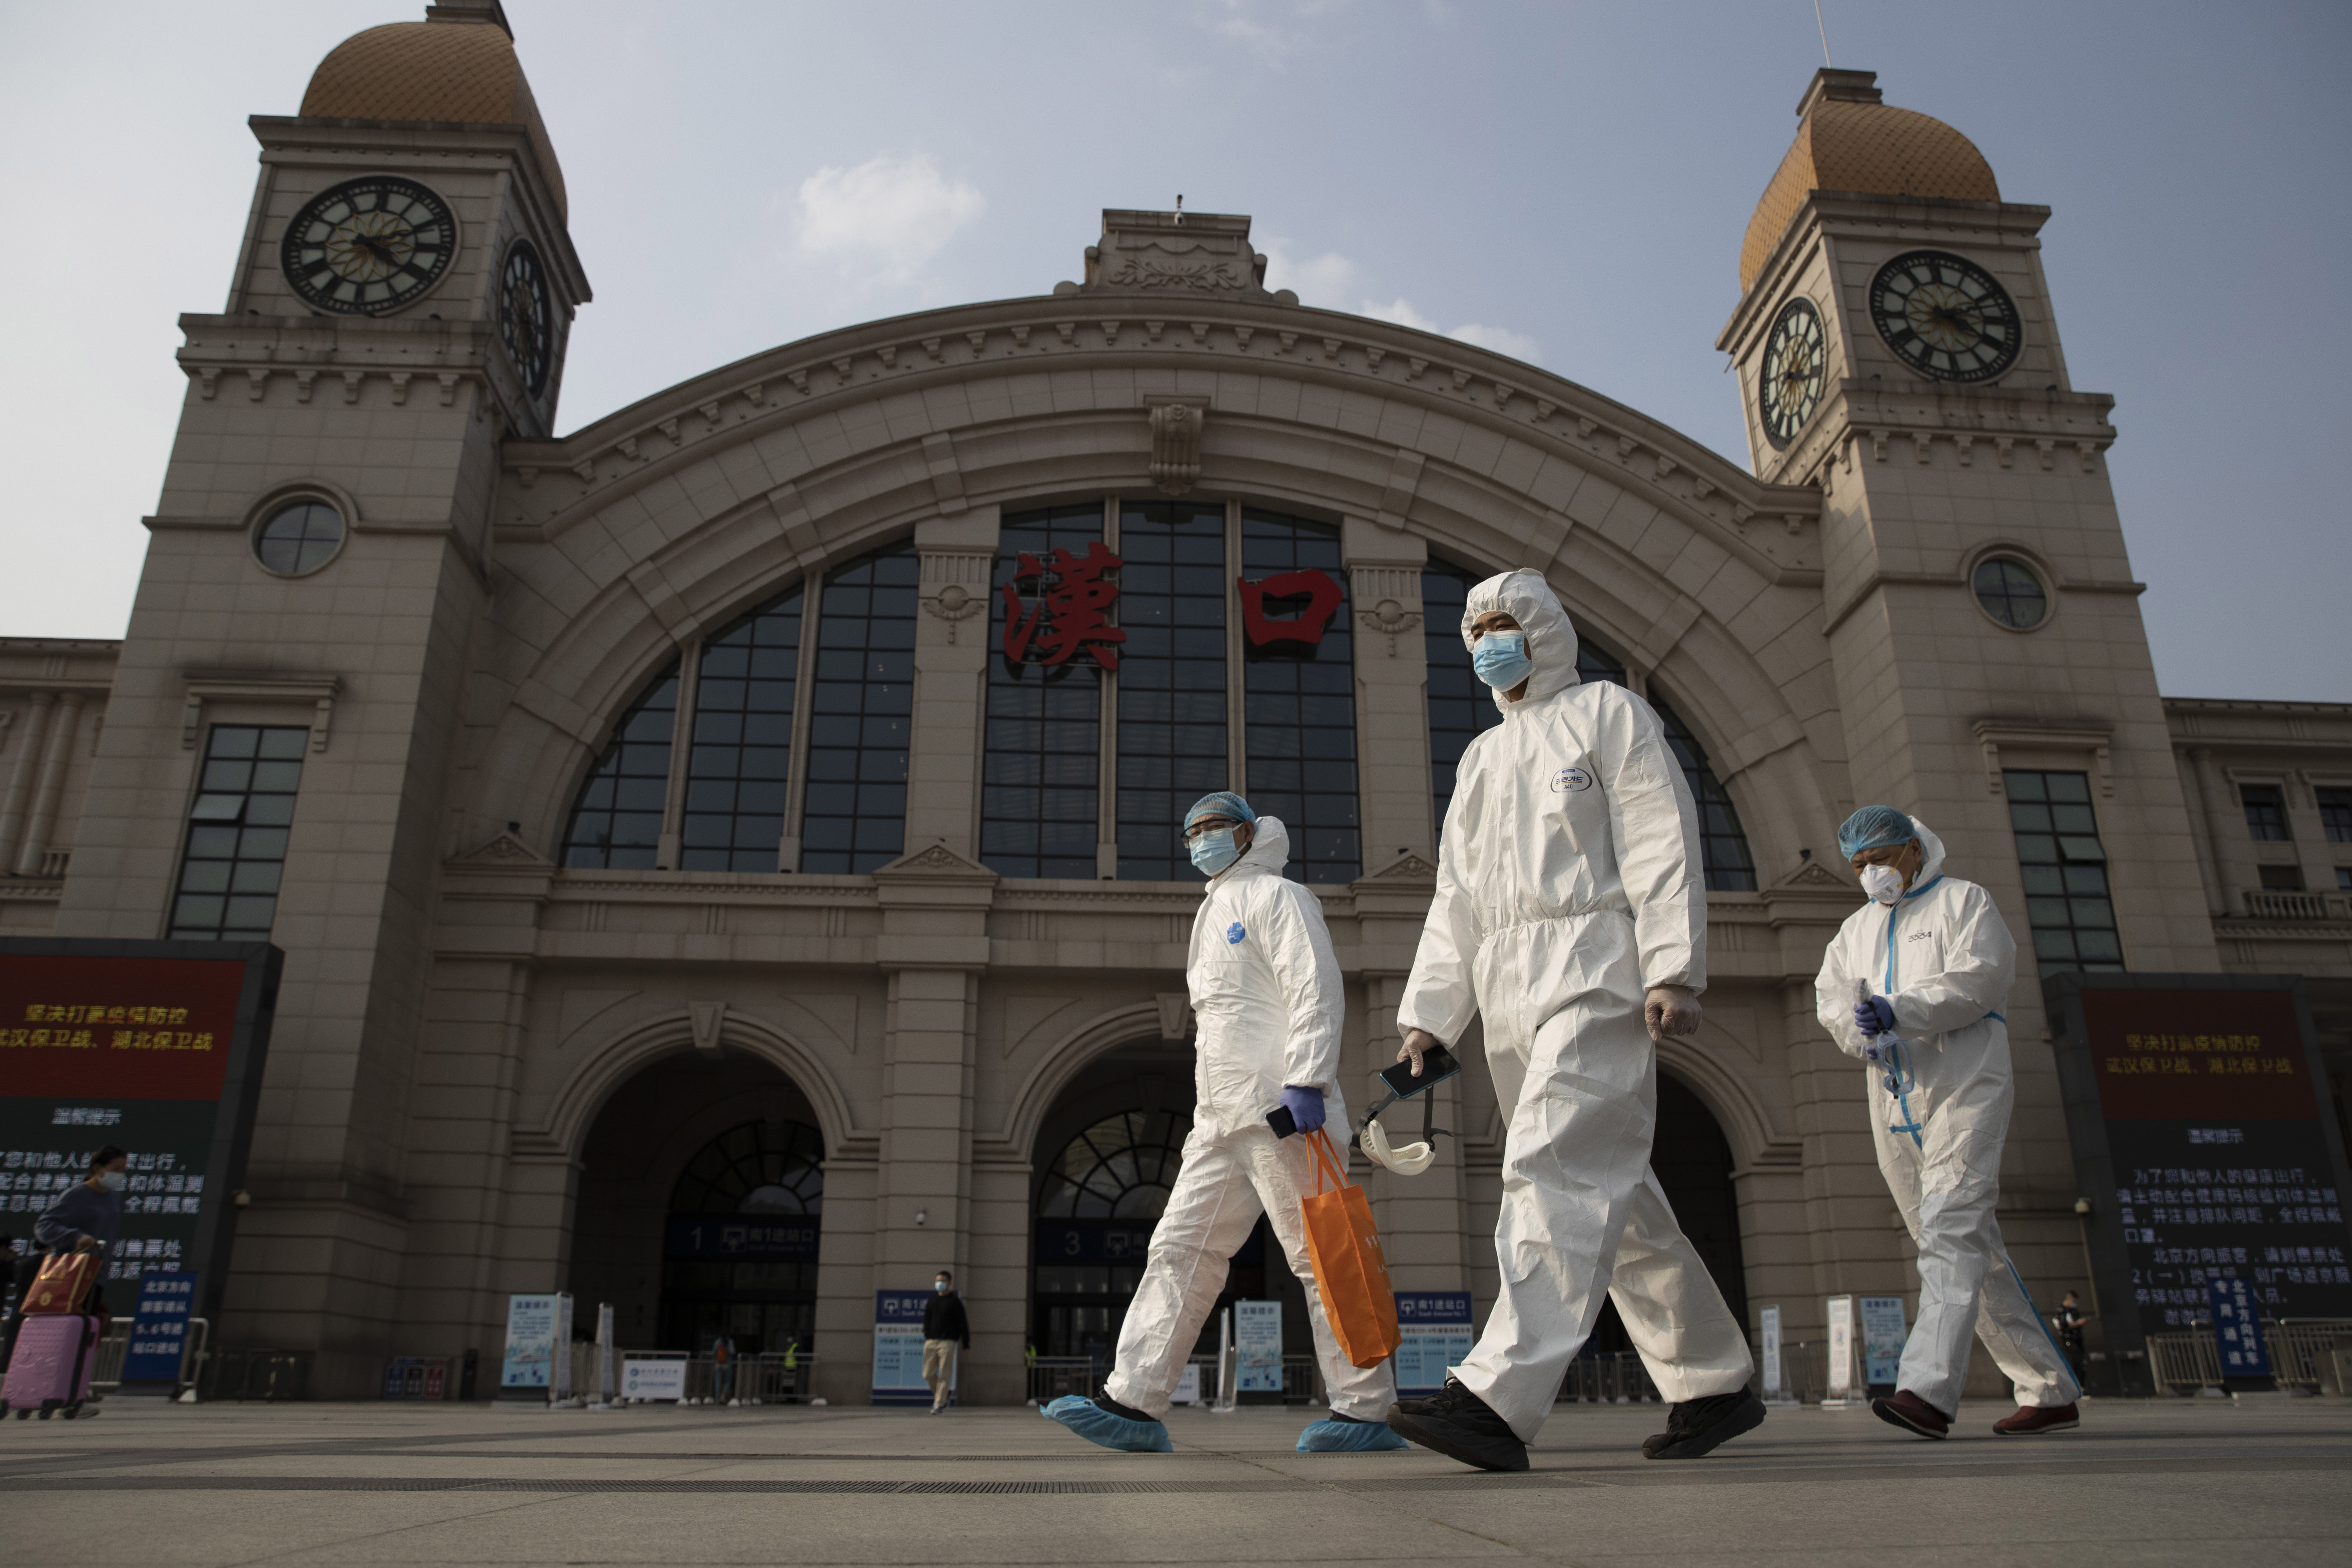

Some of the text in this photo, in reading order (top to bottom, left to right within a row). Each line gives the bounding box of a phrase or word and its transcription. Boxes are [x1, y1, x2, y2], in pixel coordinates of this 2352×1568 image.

[1003, 541, 1343, 671] 漢口
[51, 1107, 122, 1125] 温馨提示
[690, 1226, 703, 1251] 1
[1065, 1230, 1081, 1256] 3
[1418, 1299, 1466, 1310] 南1进站口
[2214, 1280, 2244, 1366] 专用通道
[2231, 1279, 2261, 1367] 北京方向列车
